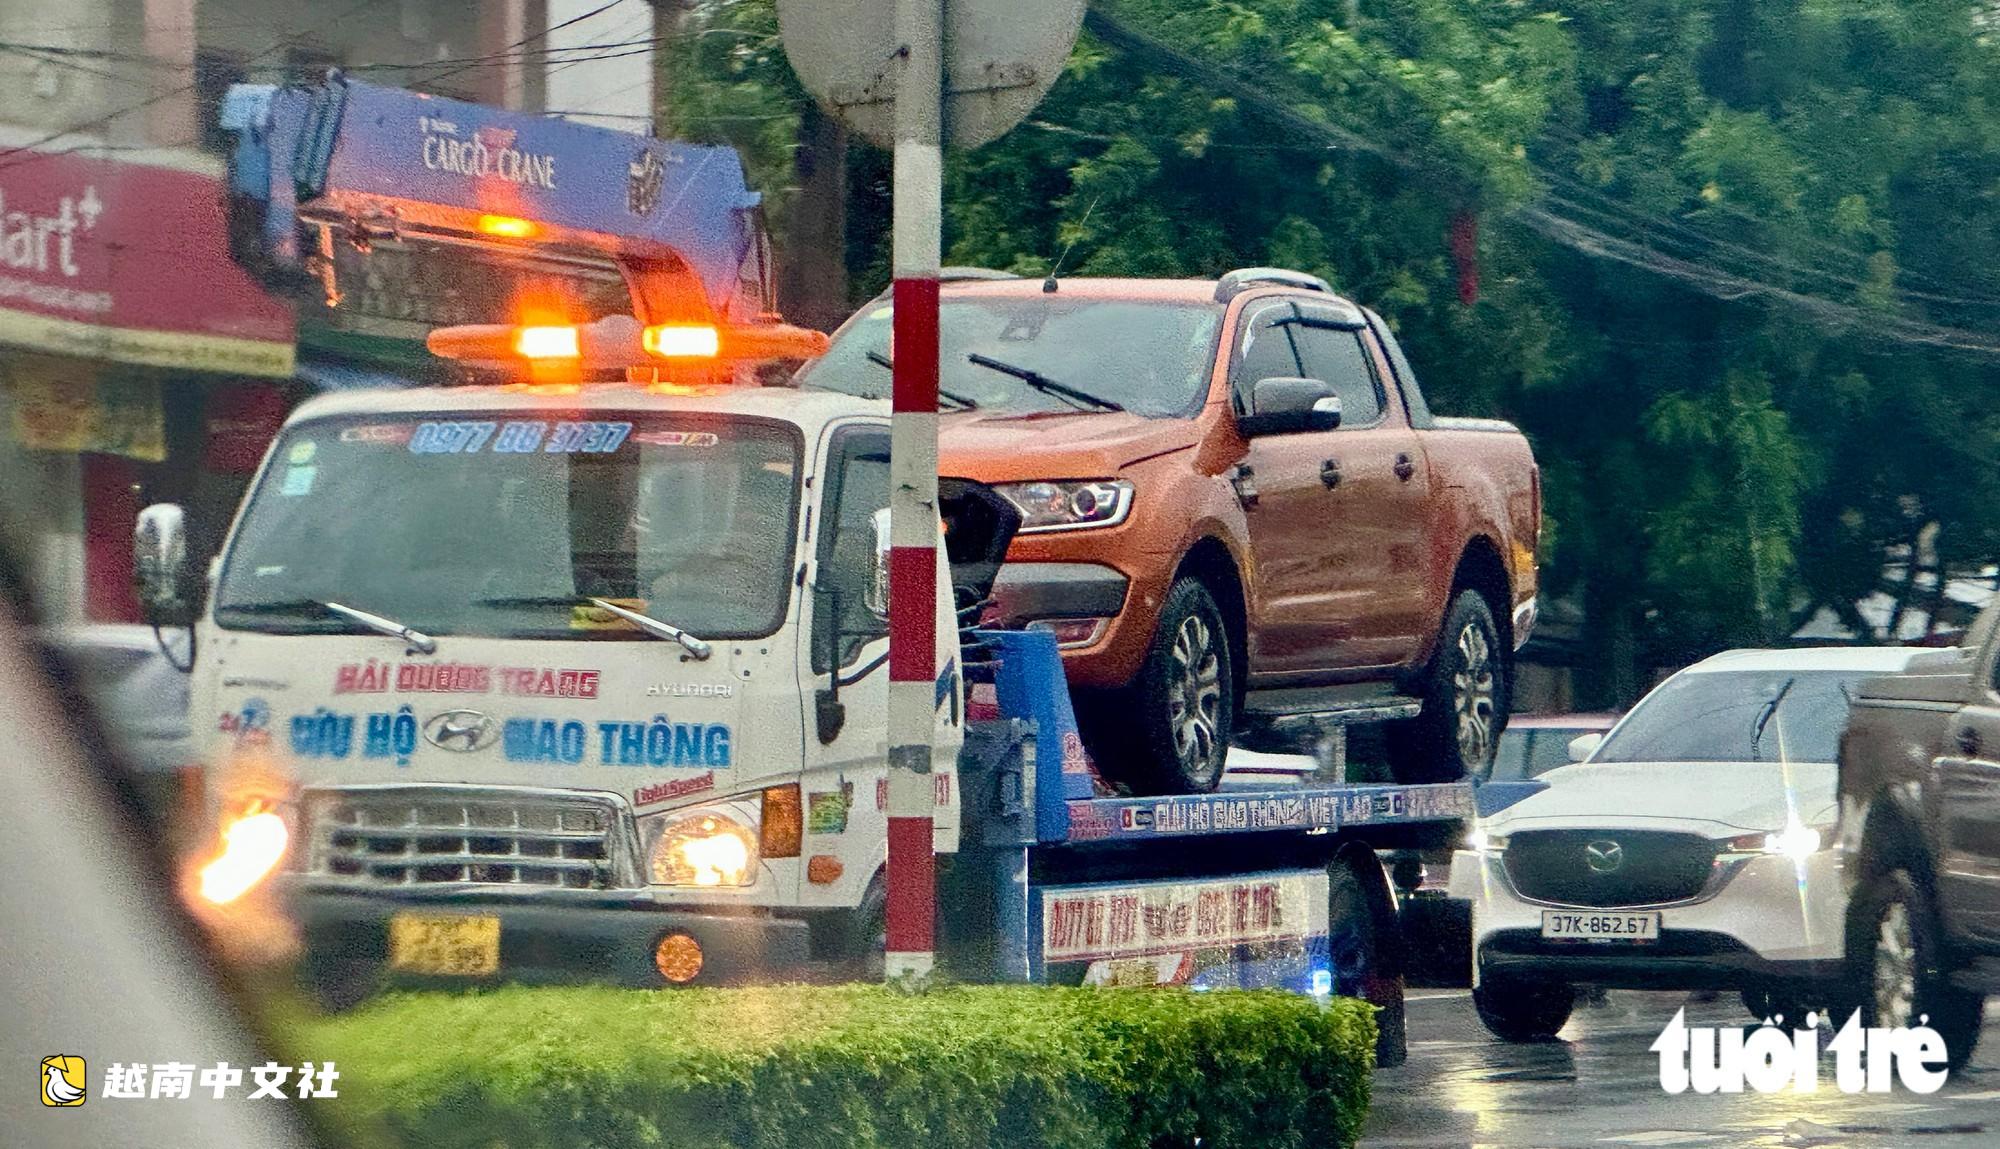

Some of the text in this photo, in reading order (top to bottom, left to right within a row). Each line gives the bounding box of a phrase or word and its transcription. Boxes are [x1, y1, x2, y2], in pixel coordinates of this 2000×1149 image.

[498, 147, 557, 190] CRANE
[0, 185, 103, 276] art+
[363, 702, 418, 768] HỘ
[597, 713, 731, 769] THÔNG
